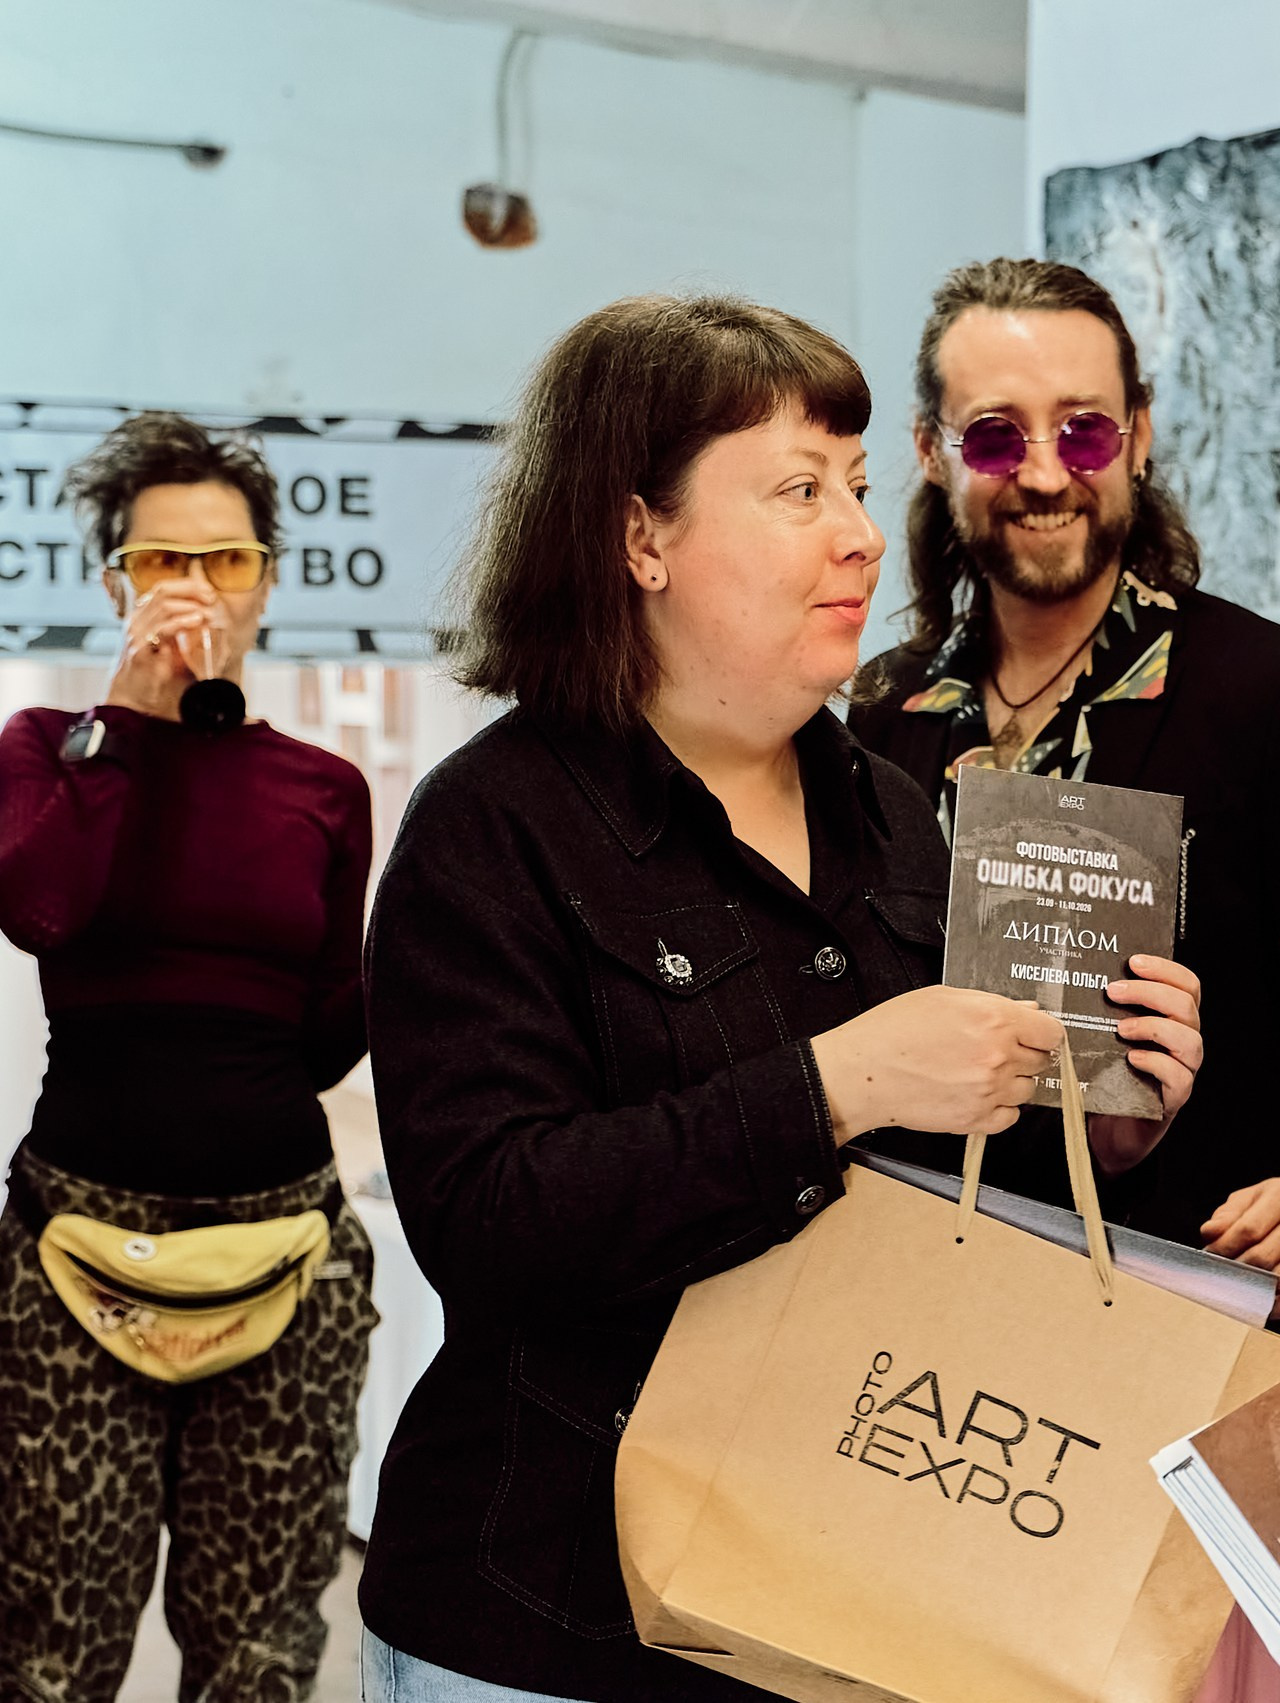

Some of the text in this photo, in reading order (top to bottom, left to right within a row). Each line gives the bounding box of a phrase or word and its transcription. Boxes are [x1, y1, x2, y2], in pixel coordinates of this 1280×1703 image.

[1016, 841, 1118, 871] ФОТОВЫСТАВКА
[977, 858, 1155, 906] ОШИБКА ФОКУСА
[1003, 920, 1119, 953] ДИПЛОМ
[1011, 963, 1108, 990] КИСЕЛЕВА ОЛЬГА
[836, 1351, 893, 1458] PHOTO
[876, 1370, 1101, 1484] ART
[858, 1423, 1065, 1539] EXPO
